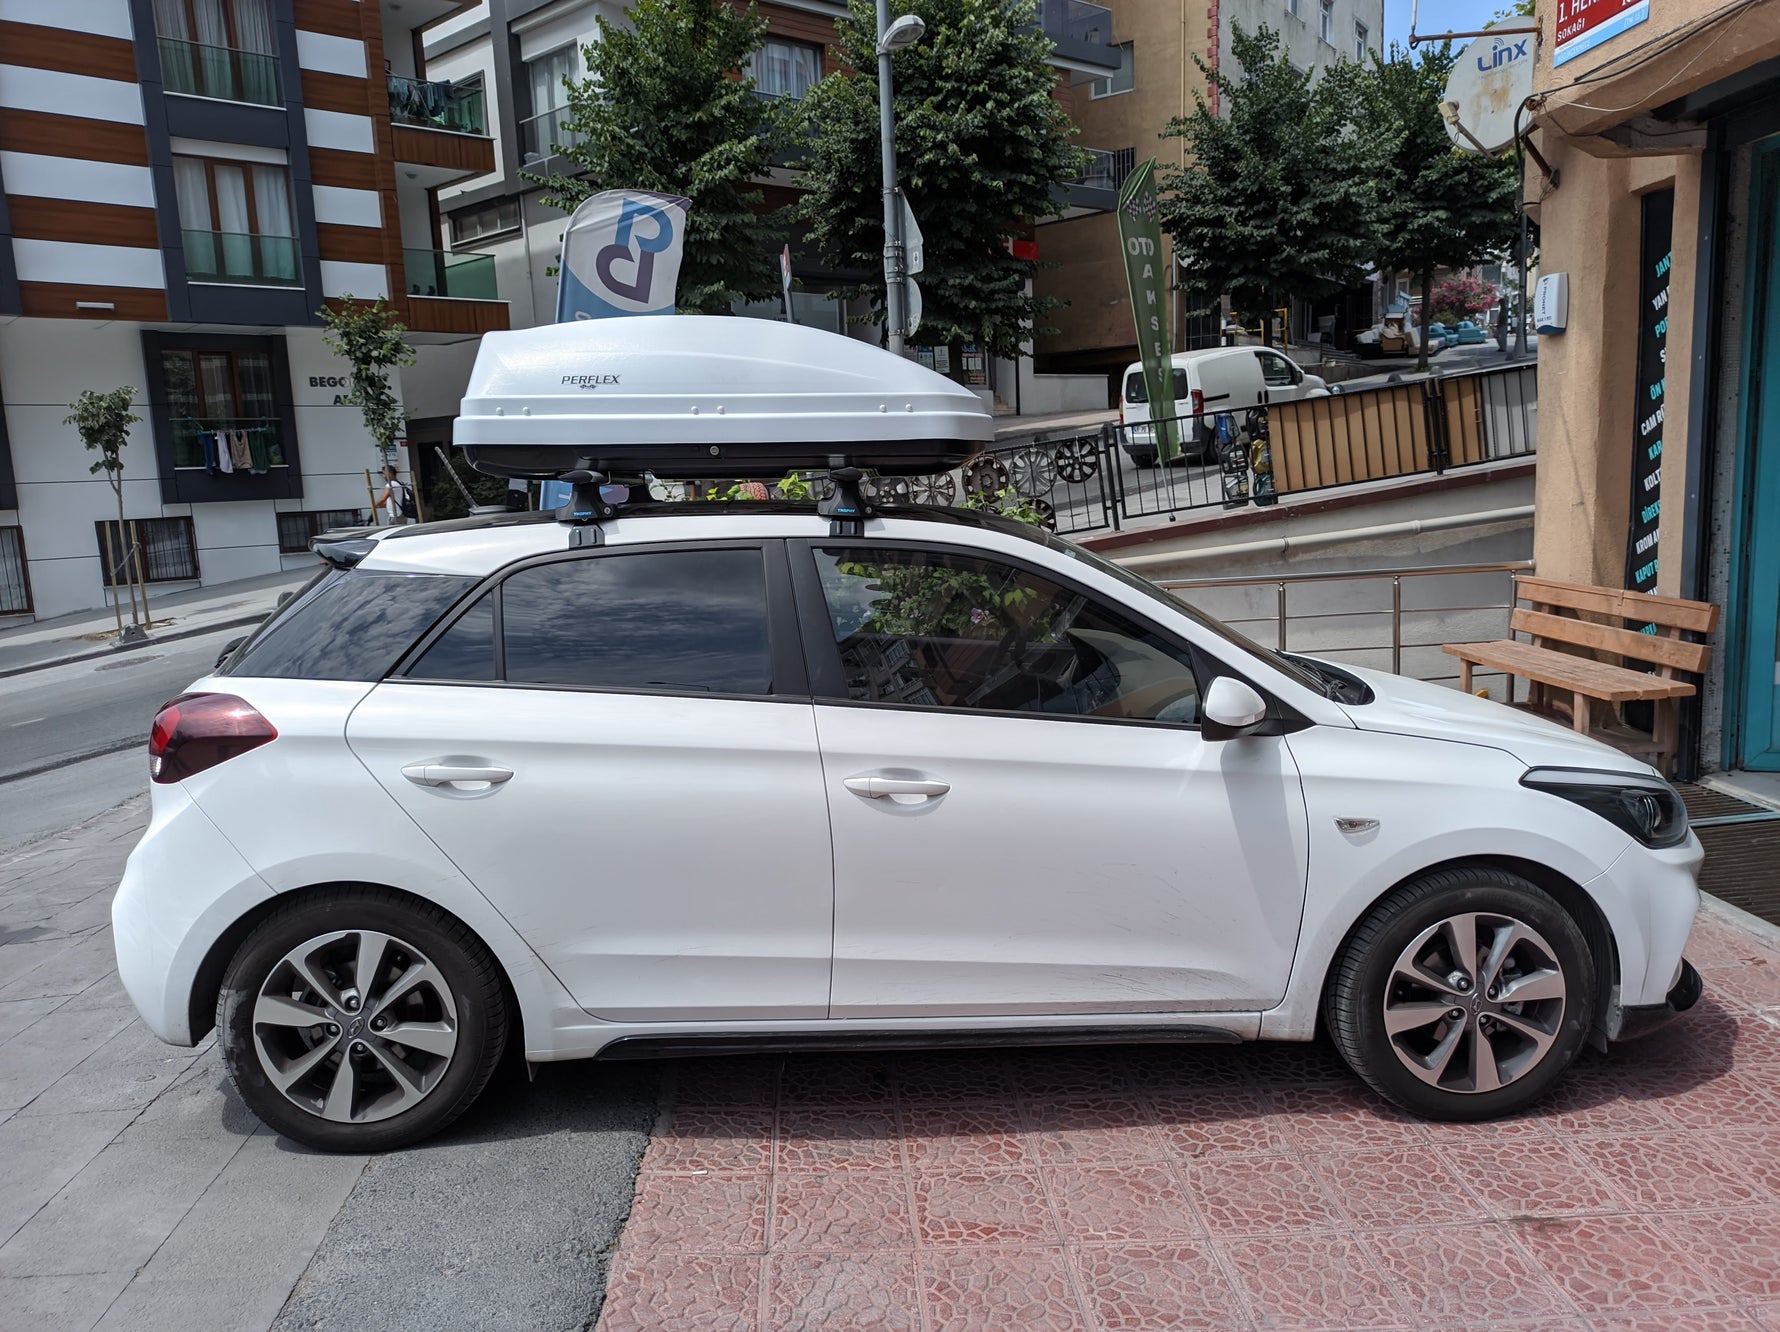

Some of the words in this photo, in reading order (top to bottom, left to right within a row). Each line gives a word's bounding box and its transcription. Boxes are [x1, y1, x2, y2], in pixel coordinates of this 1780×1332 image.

[1557, 17, 1586, 42] SOKAĞI
[1127, 237, 1155, 256] OTO
[1652, 289, 1668, 311] YAN
[561, 374, 621, 385] PERFLEX
[1641, 412, 1658, 436] CAM
[1635, 532, 1654, 555] KROM
[1634, 564, 1655, 584] KAPUT
